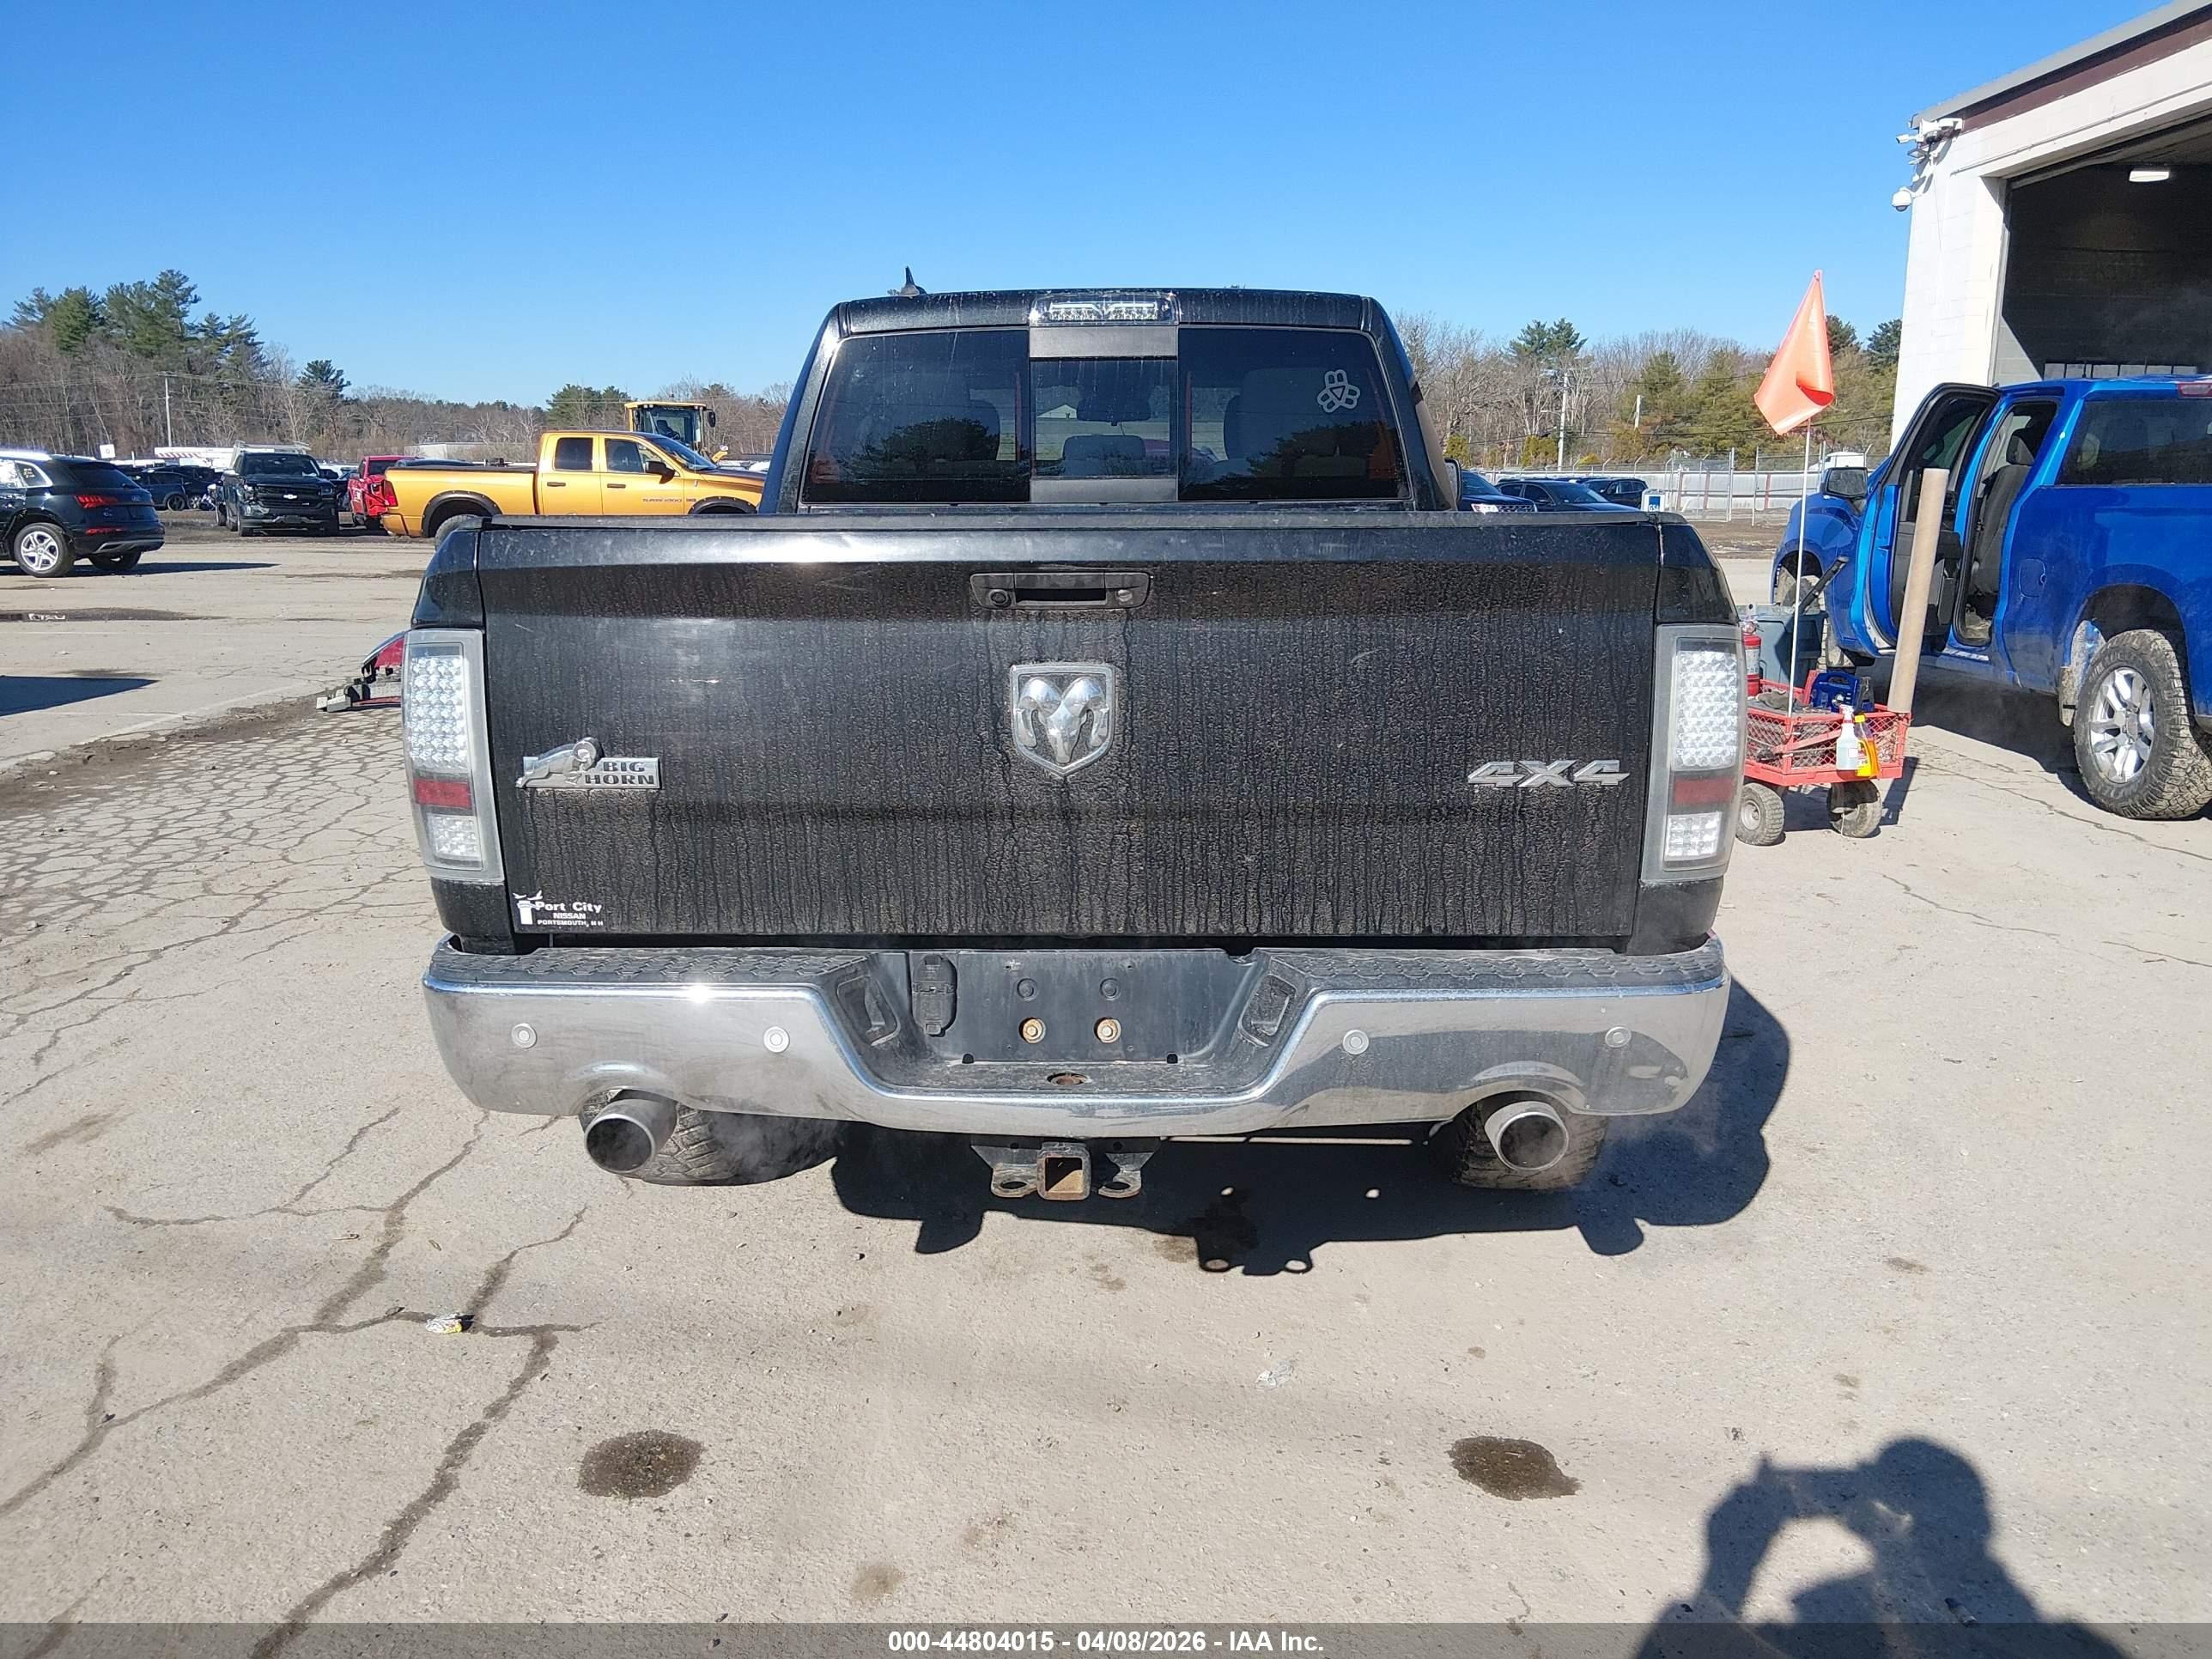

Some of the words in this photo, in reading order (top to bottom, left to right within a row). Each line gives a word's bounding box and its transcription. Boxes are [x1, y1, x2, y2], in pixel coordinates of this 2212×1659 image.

[603, 761, 645, 772] BIG
[585, 774, 655, 785] HORN
[1468, 760, 1631, 787] 4X4
[535, 901, 567, 911] Port
[572, 901, 603, 914] City
